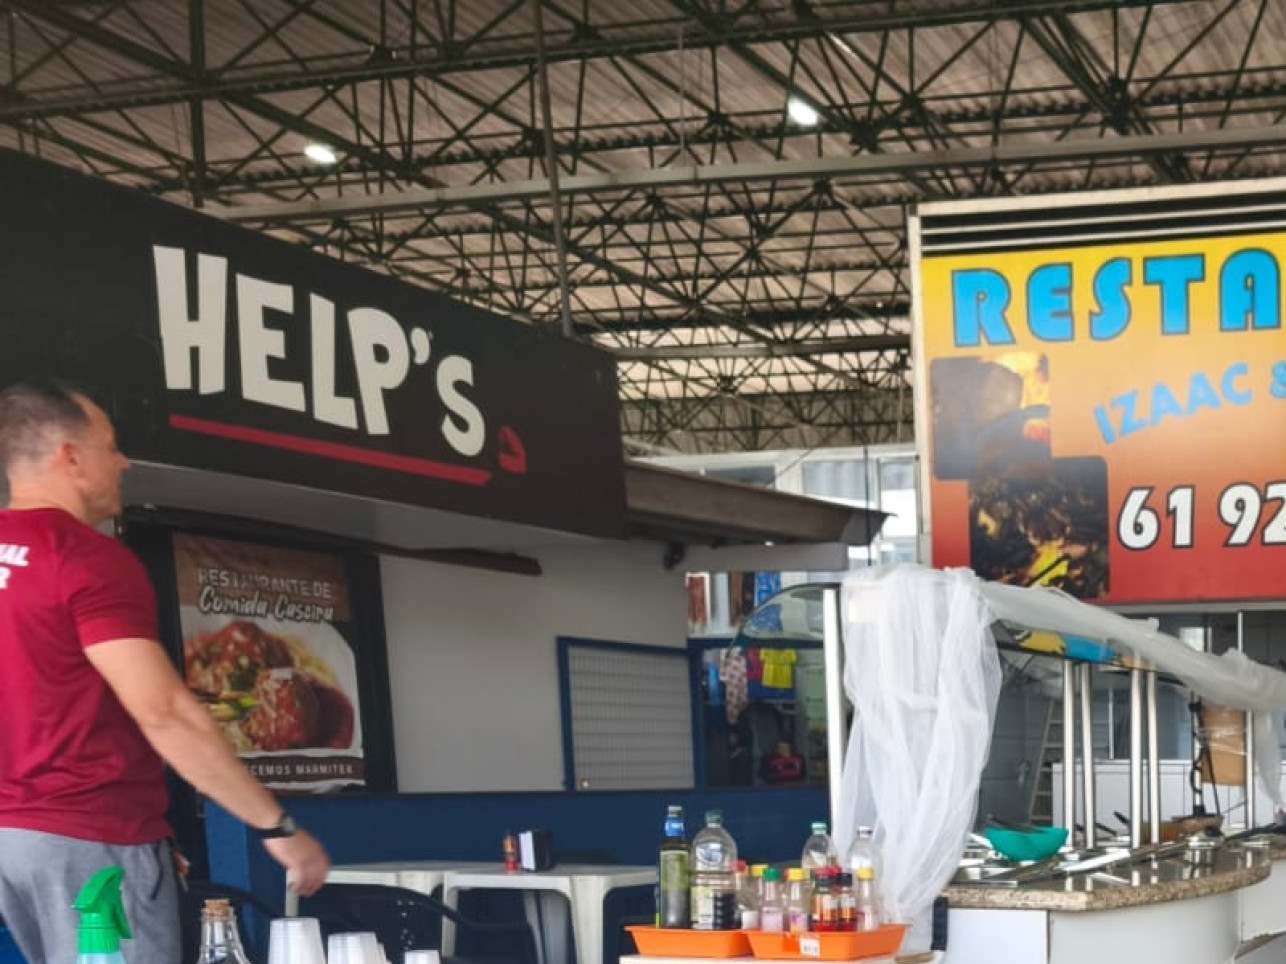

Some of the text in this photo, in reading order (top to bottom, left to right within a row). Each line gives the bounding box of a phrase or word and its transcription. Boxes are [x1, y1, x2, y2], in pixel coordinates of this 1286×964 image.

[1093, 362, 1253, 444] IZAAC
[1117, 485, 1195, 550] 61
[198, 568, 332, 598] RESTAURANTE DE
[200, 585, 268, 617] Comida
